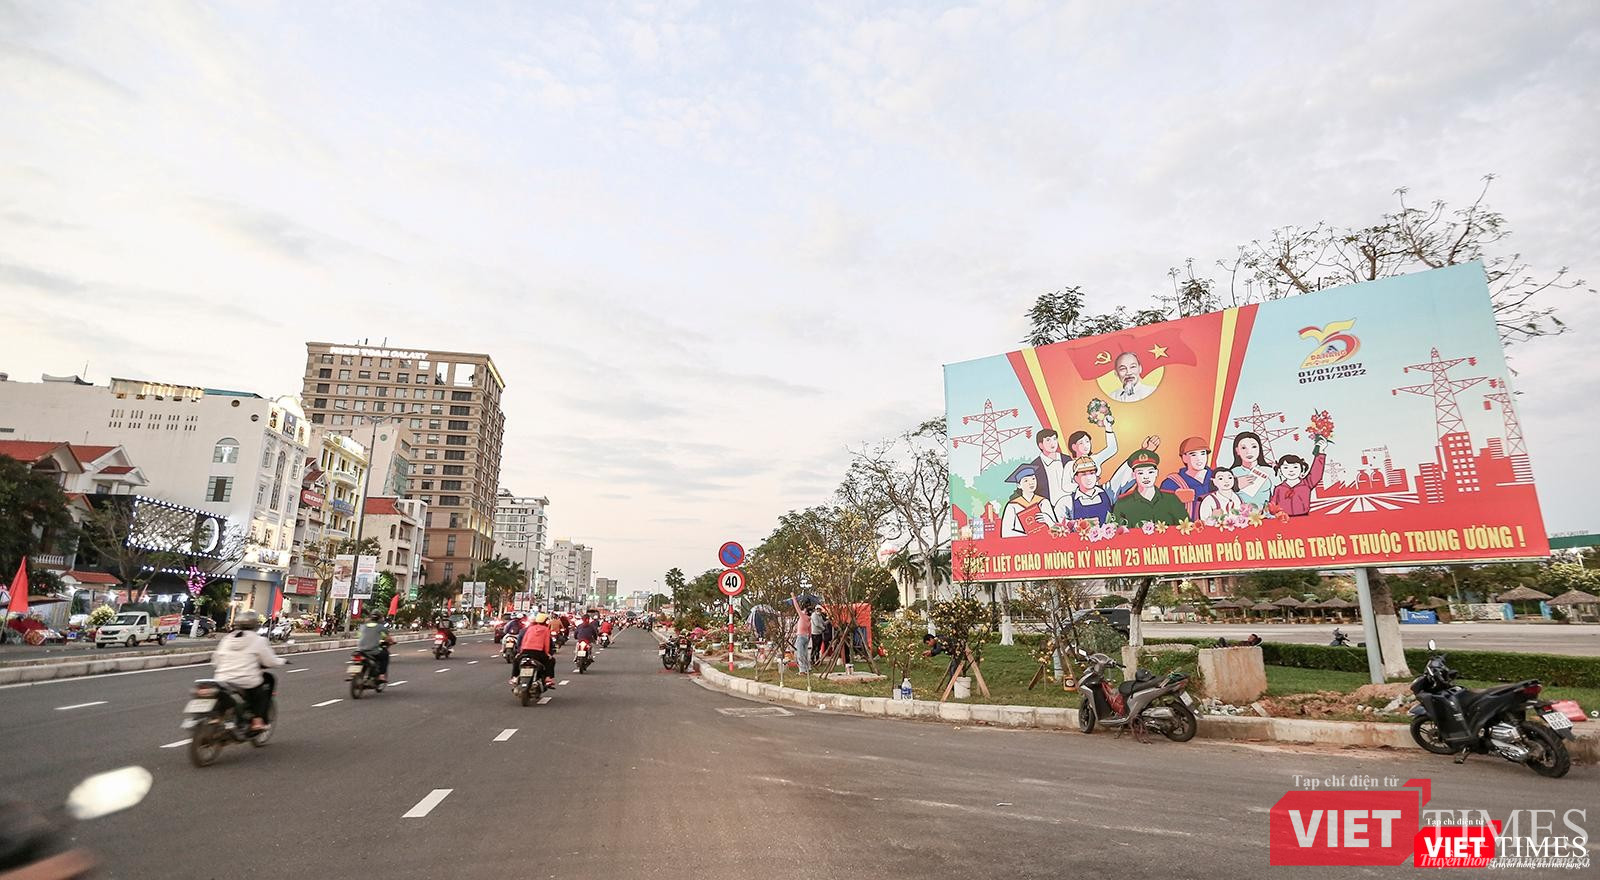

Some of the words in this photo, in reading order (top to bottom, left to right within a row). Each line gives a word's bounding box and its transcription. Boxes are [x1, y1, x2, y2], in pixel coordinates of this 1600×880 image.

[1298, 363, 1363, 378] 01/01/1997
[1299, 369, 1367, 384] 01/01/2022
[993, 553, 1012, 576] LIỆT
[1014, 551, 1041, 571] CHÀO
[1044, 550, 1075, 570] MỪNG
[1077, 547, 1092, 568] KỶ
[1094, 547, 1122, 571] NIỆM
[1124, 548, 1140, 566] 25
[1143, 544, 1170, 566] NĂM
[1172, 542, 1213, 564] THÀNH
[1216, 536, 1243, 562] PHỐ
[1245, 538, 1265, 561] ĐÀ
[1267, 533, 1306, 560] NẴNG
[1308, 533, 1347, 560] TRỰC
[1349, 529, 1402, 558] THUỘC
[1404, 528, 1461, 553] TRUNG
[1463, 524, 1514, 550] ƯƠNG
[725, 576, 738, 588] 40
